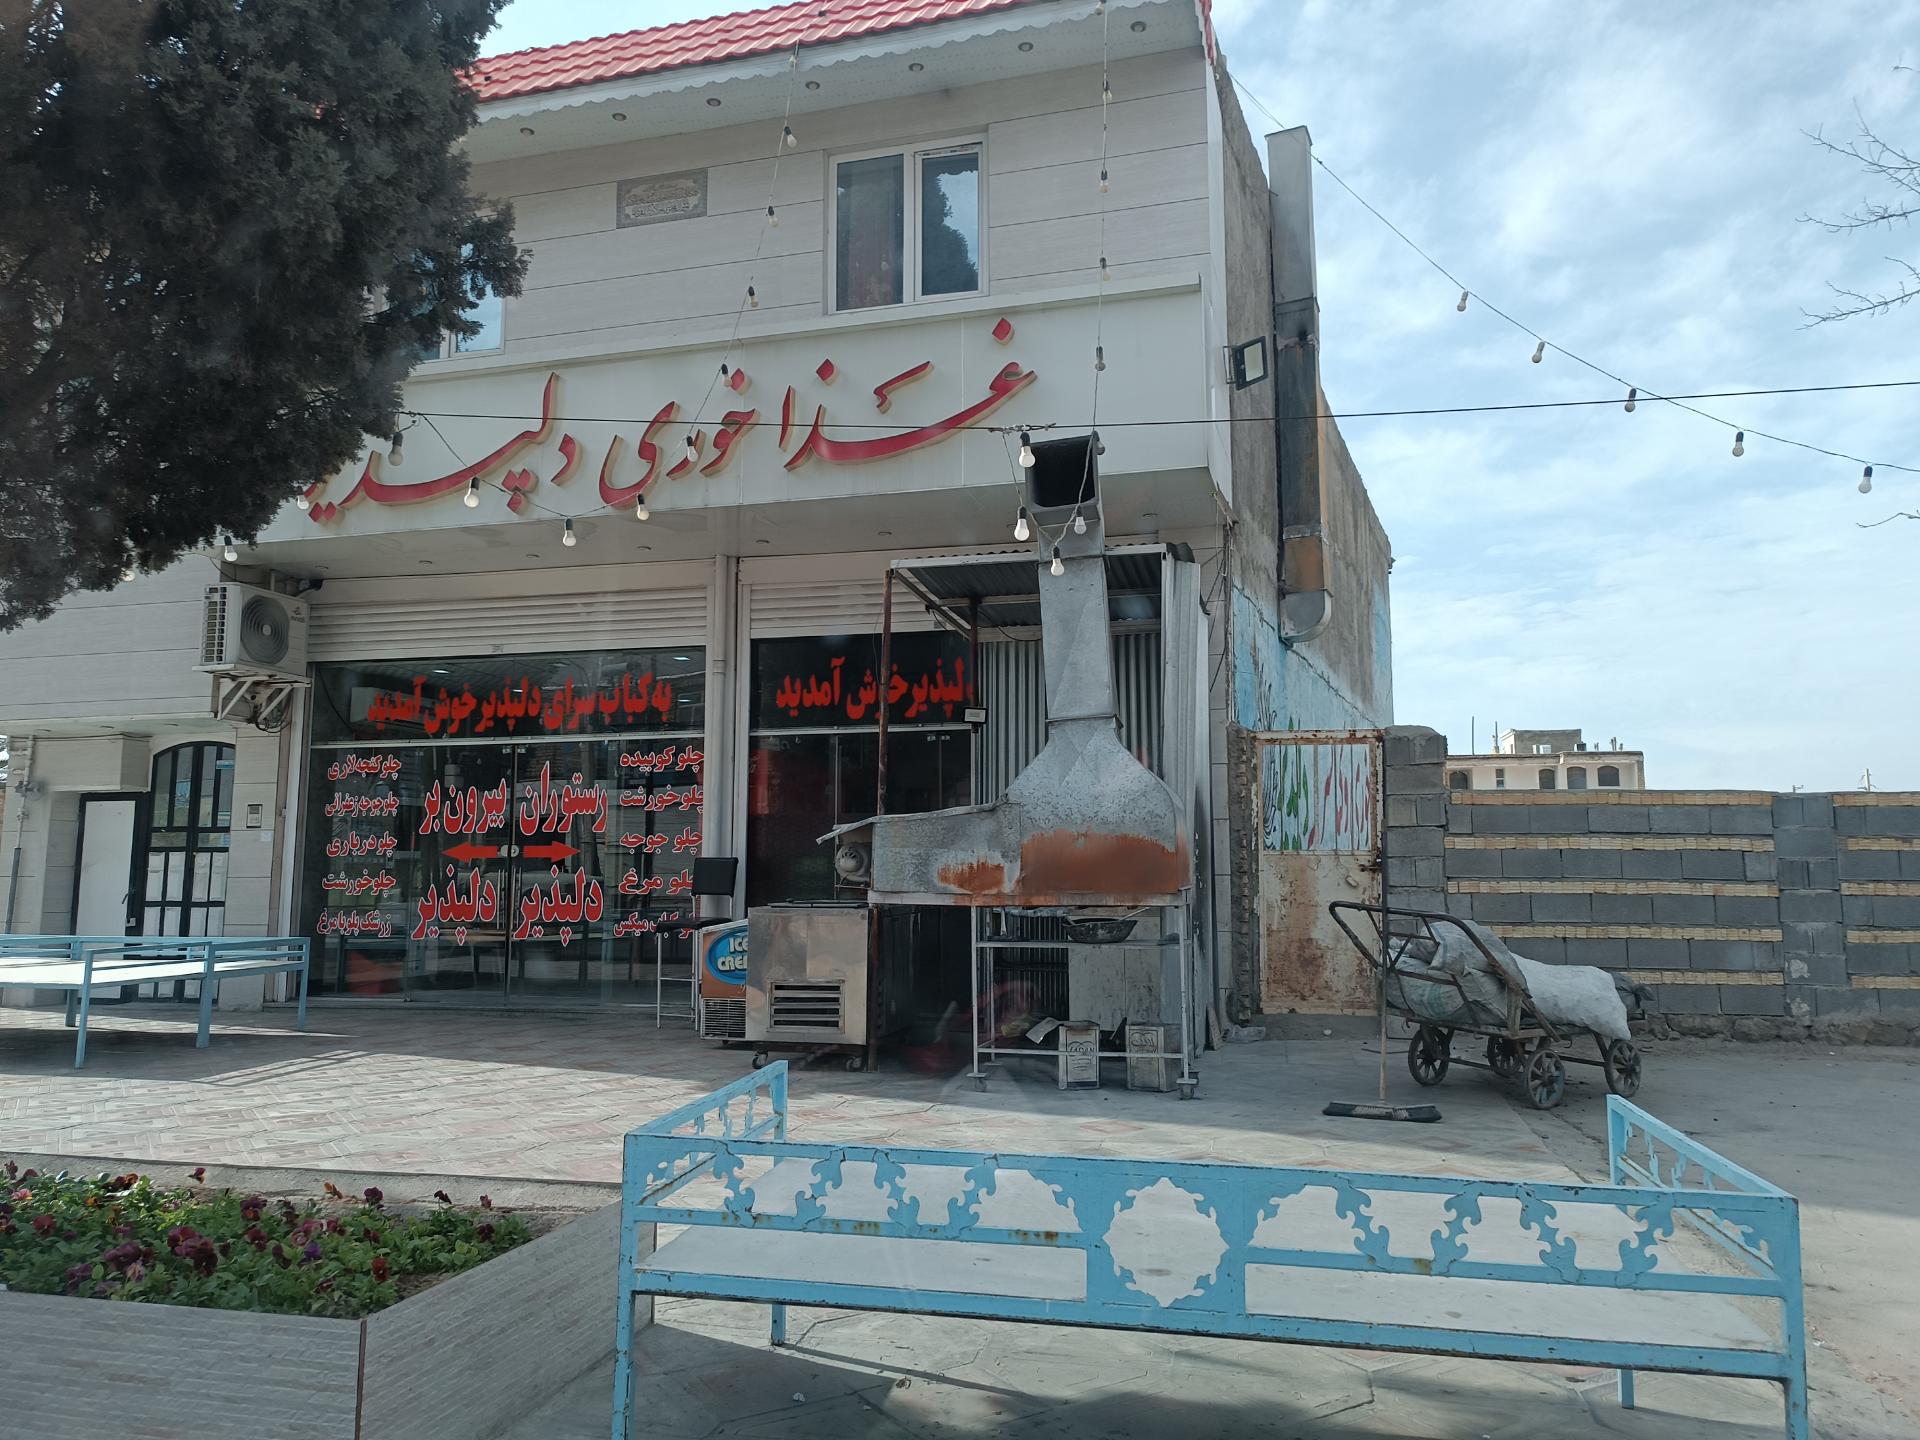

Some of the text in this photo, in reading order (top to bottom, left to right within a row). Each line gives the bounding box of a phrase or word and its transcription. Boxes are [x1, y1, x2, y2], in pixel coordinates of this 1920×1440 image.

[776, 656, 847, 718] آمدید
[846, 663, 909, 720] خش
[367, 672, 673, 738] به کباب سرای دلپذیر خوش آمدید
[380, 755, 401, 780] چلو
[620, 746, 704, 773] چلو کوبیده
[359, 797, 382, 816] جوجه
[382, 791, 400, 816] چلو
[444, 778, 507, 834] بیرون
[519, 760, 608, 836] رستوران
[619, 785, 680, 811] خورشت
[377, 830, 397, 856] چلو
[619, 827, 703, 855] چلو جوجه
[322, 868, 396, 896] چلو خورشت
[619, 867, 694, 894] لو مرغ
[411, 863, 496, 946] دلپذیر
[514, 865, 603, 946] دلپذیر
[360, 910, 392, 937] زرشک
[614, 912, 648, 937] میکس
